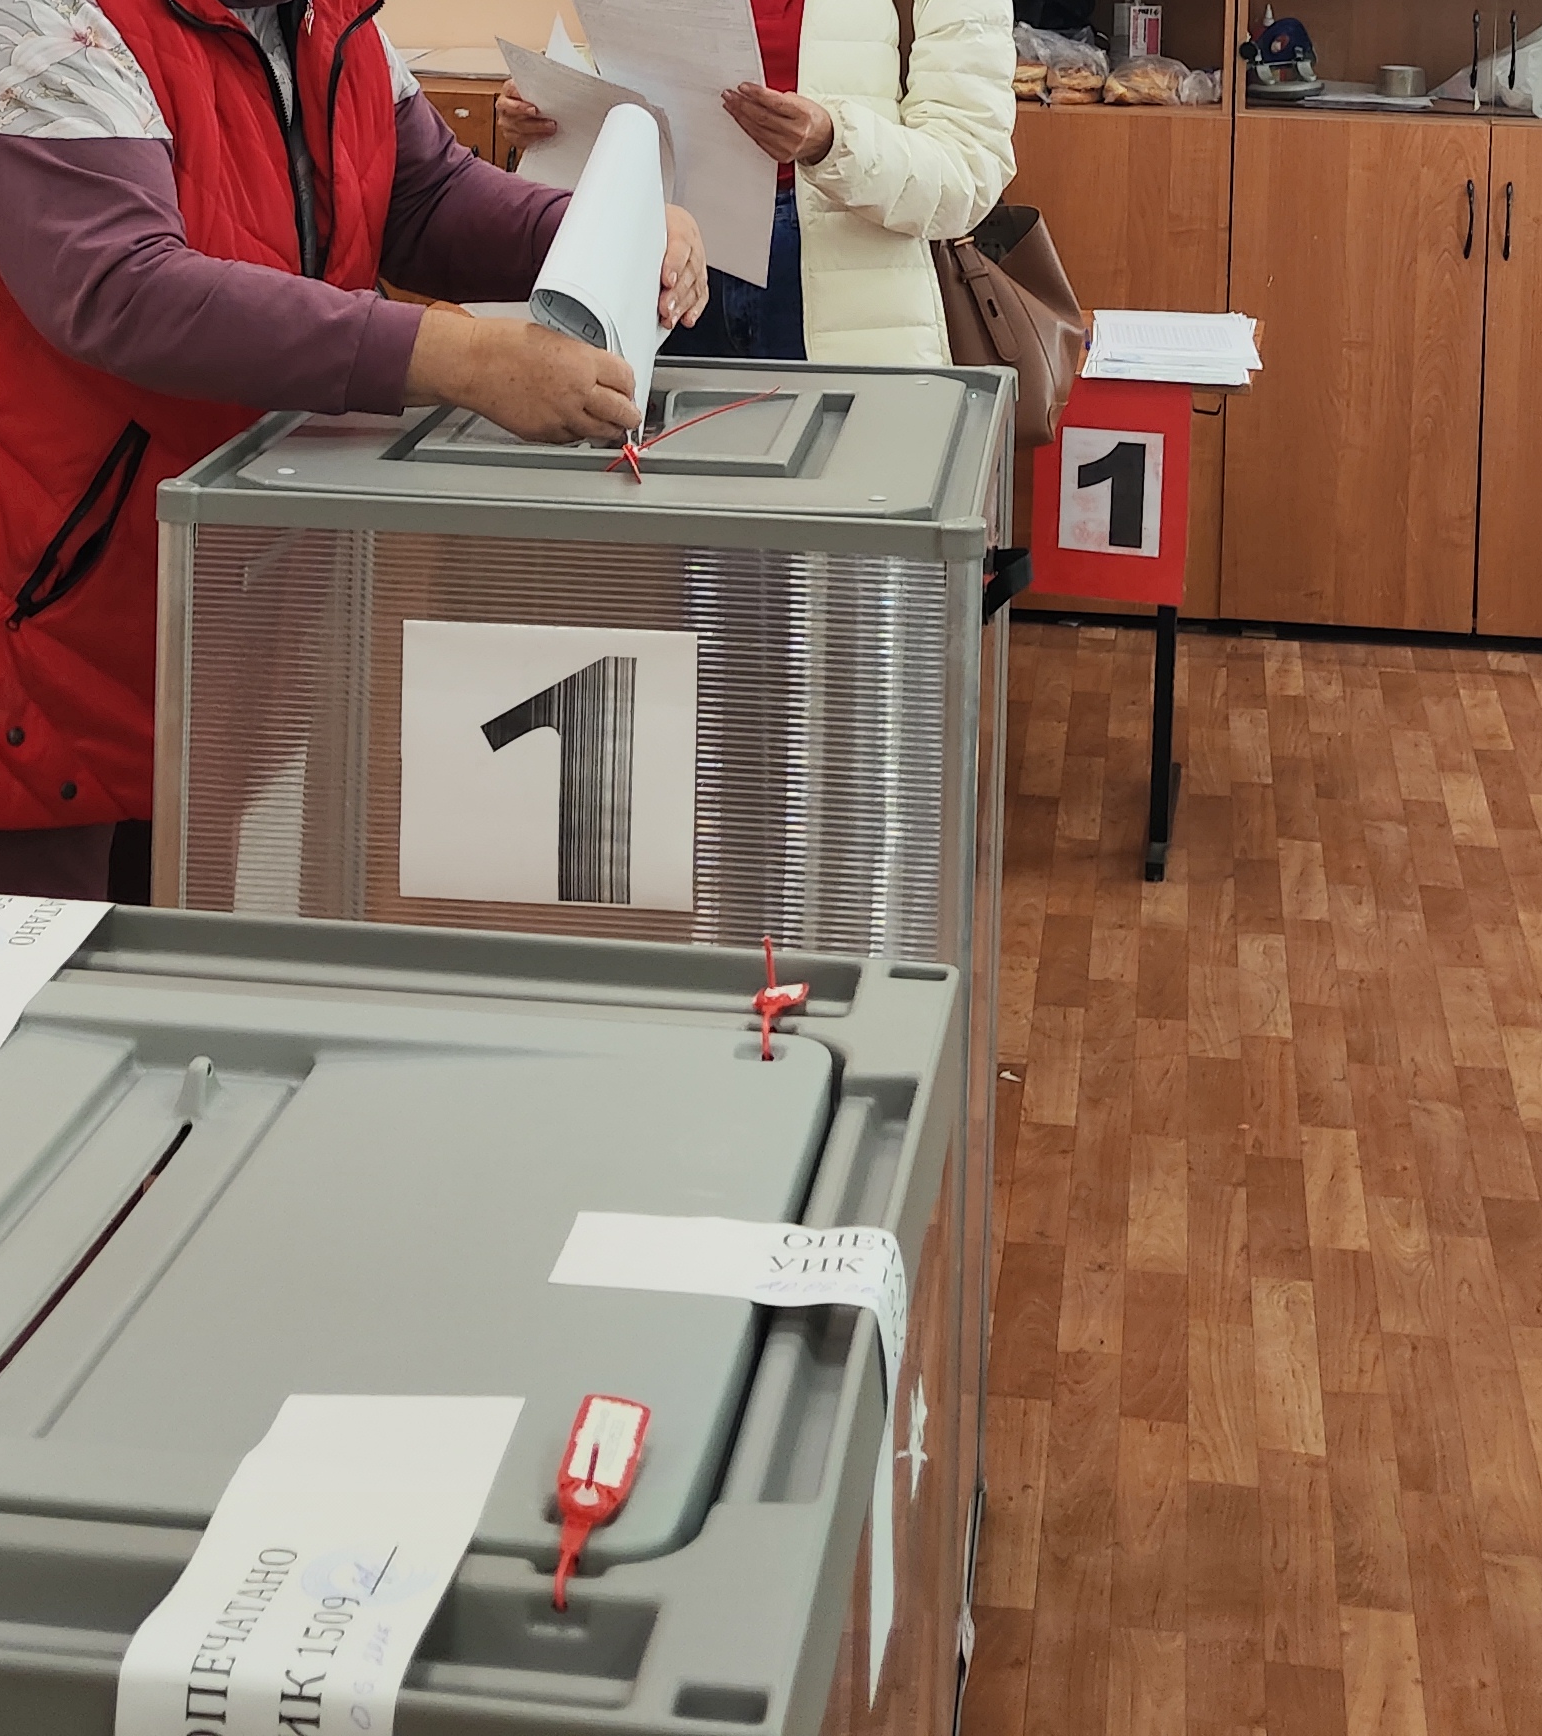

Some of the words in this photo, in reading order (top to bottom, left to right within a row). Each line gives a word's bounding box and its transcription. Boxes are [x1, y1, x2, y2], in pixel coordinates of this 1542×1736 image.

[1077, 441, 1147, 550] 1
[479, 655, 638, 905] 1
[8, 898, 67, 946] АТАНО
[185, 1548, 298, 1736] ПЕЧАТАНО
[296, 1596, 361, 1657] 1509
[277, 1668, 327, 1736] ИК
